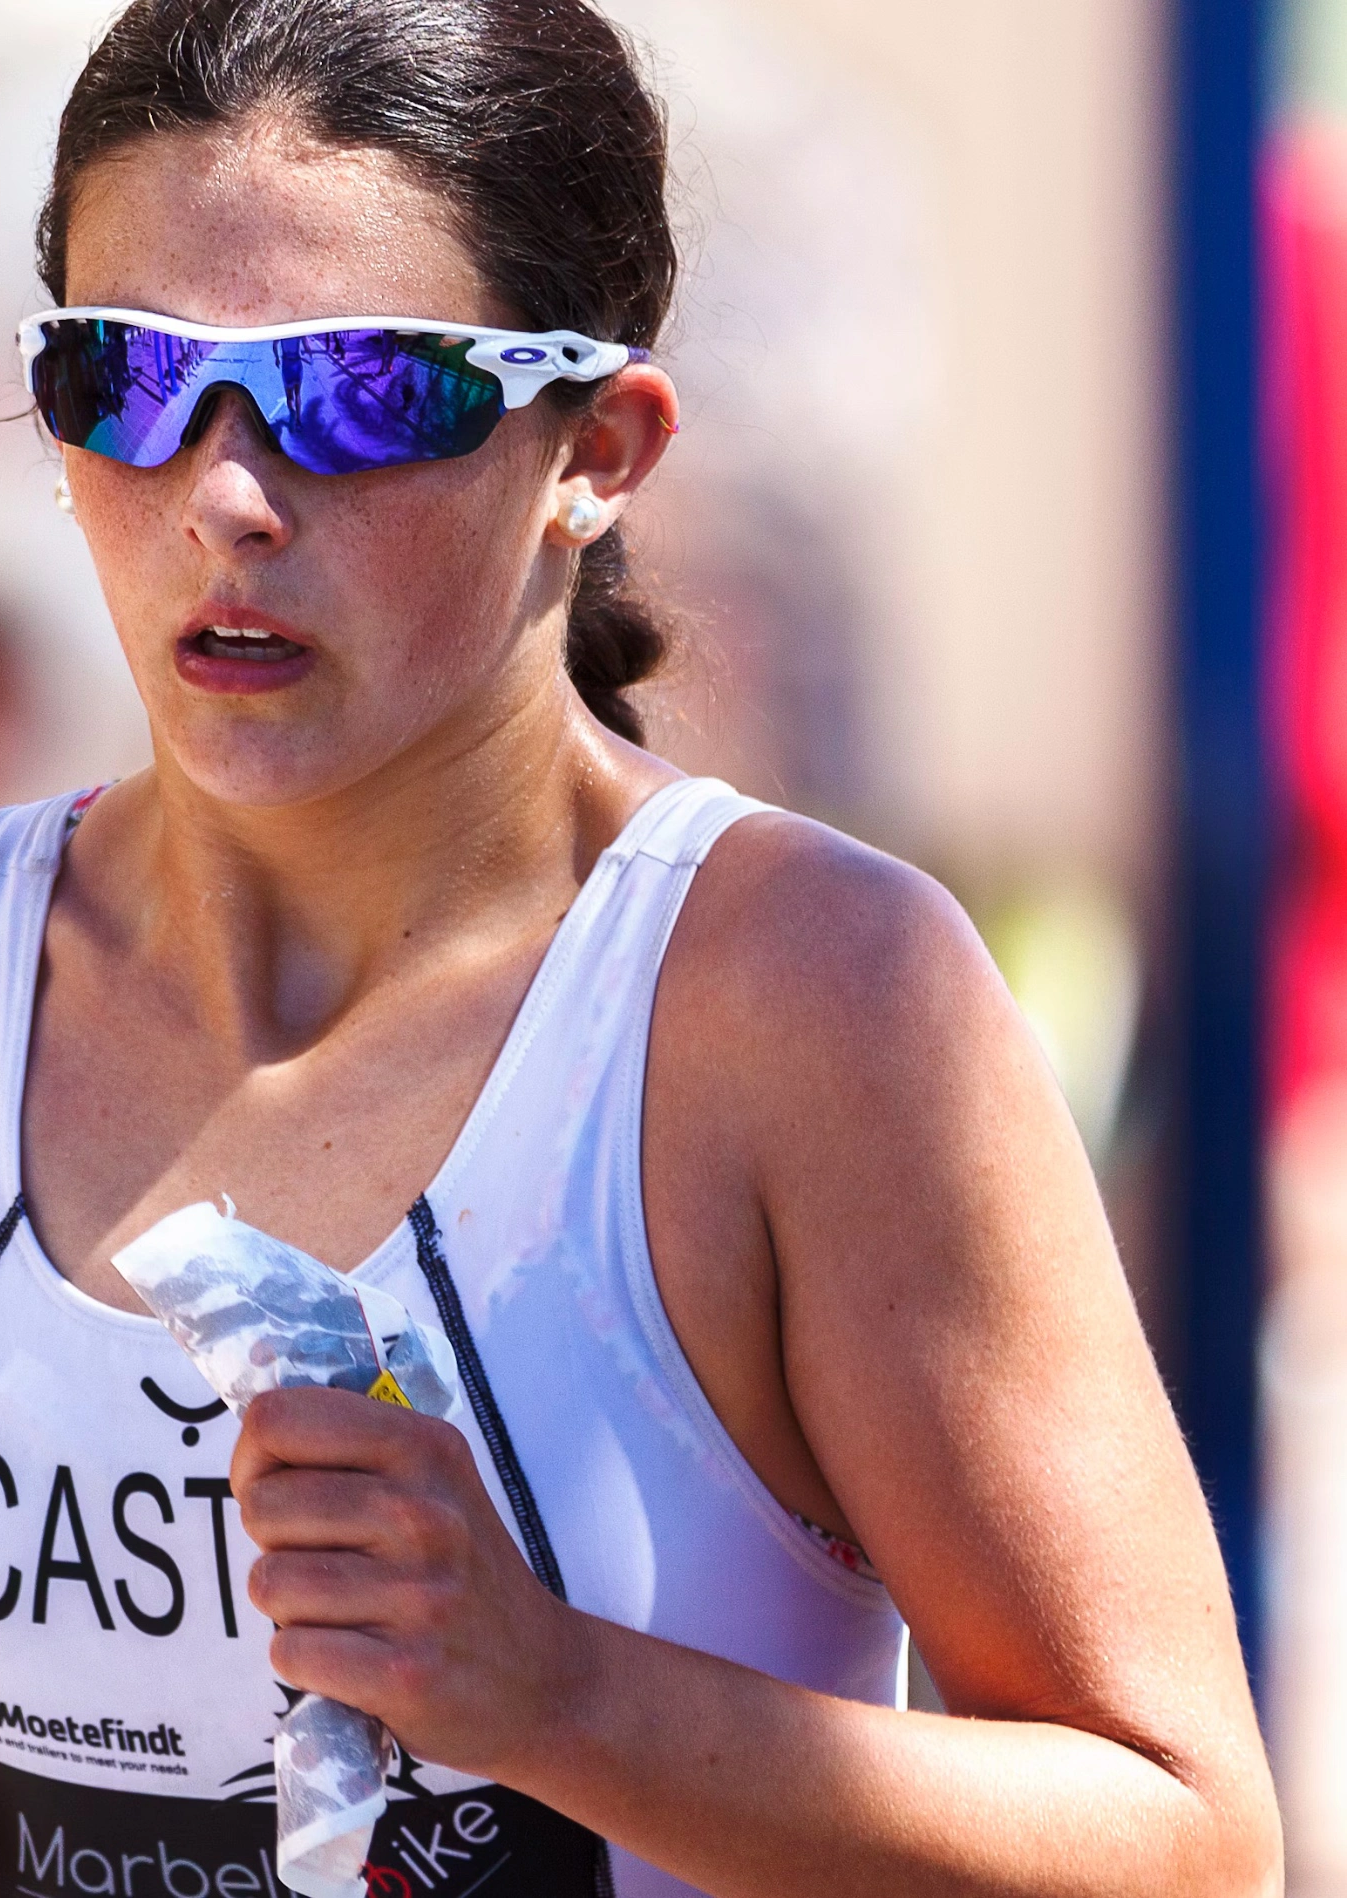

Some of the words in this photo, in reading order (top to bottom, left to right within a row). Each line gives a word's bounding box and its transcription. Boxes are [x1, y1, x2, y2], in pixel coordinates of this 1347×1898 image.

[4, 1738, 26, 1751] and
[69, 1752, 83, 1764] to
[85, 1756, 117, 1769] meet
[119, 1761, 147, 1773] your
[150, 1762, 189, 1776] needs
[18, 1811, 297, 1898] Marbel
